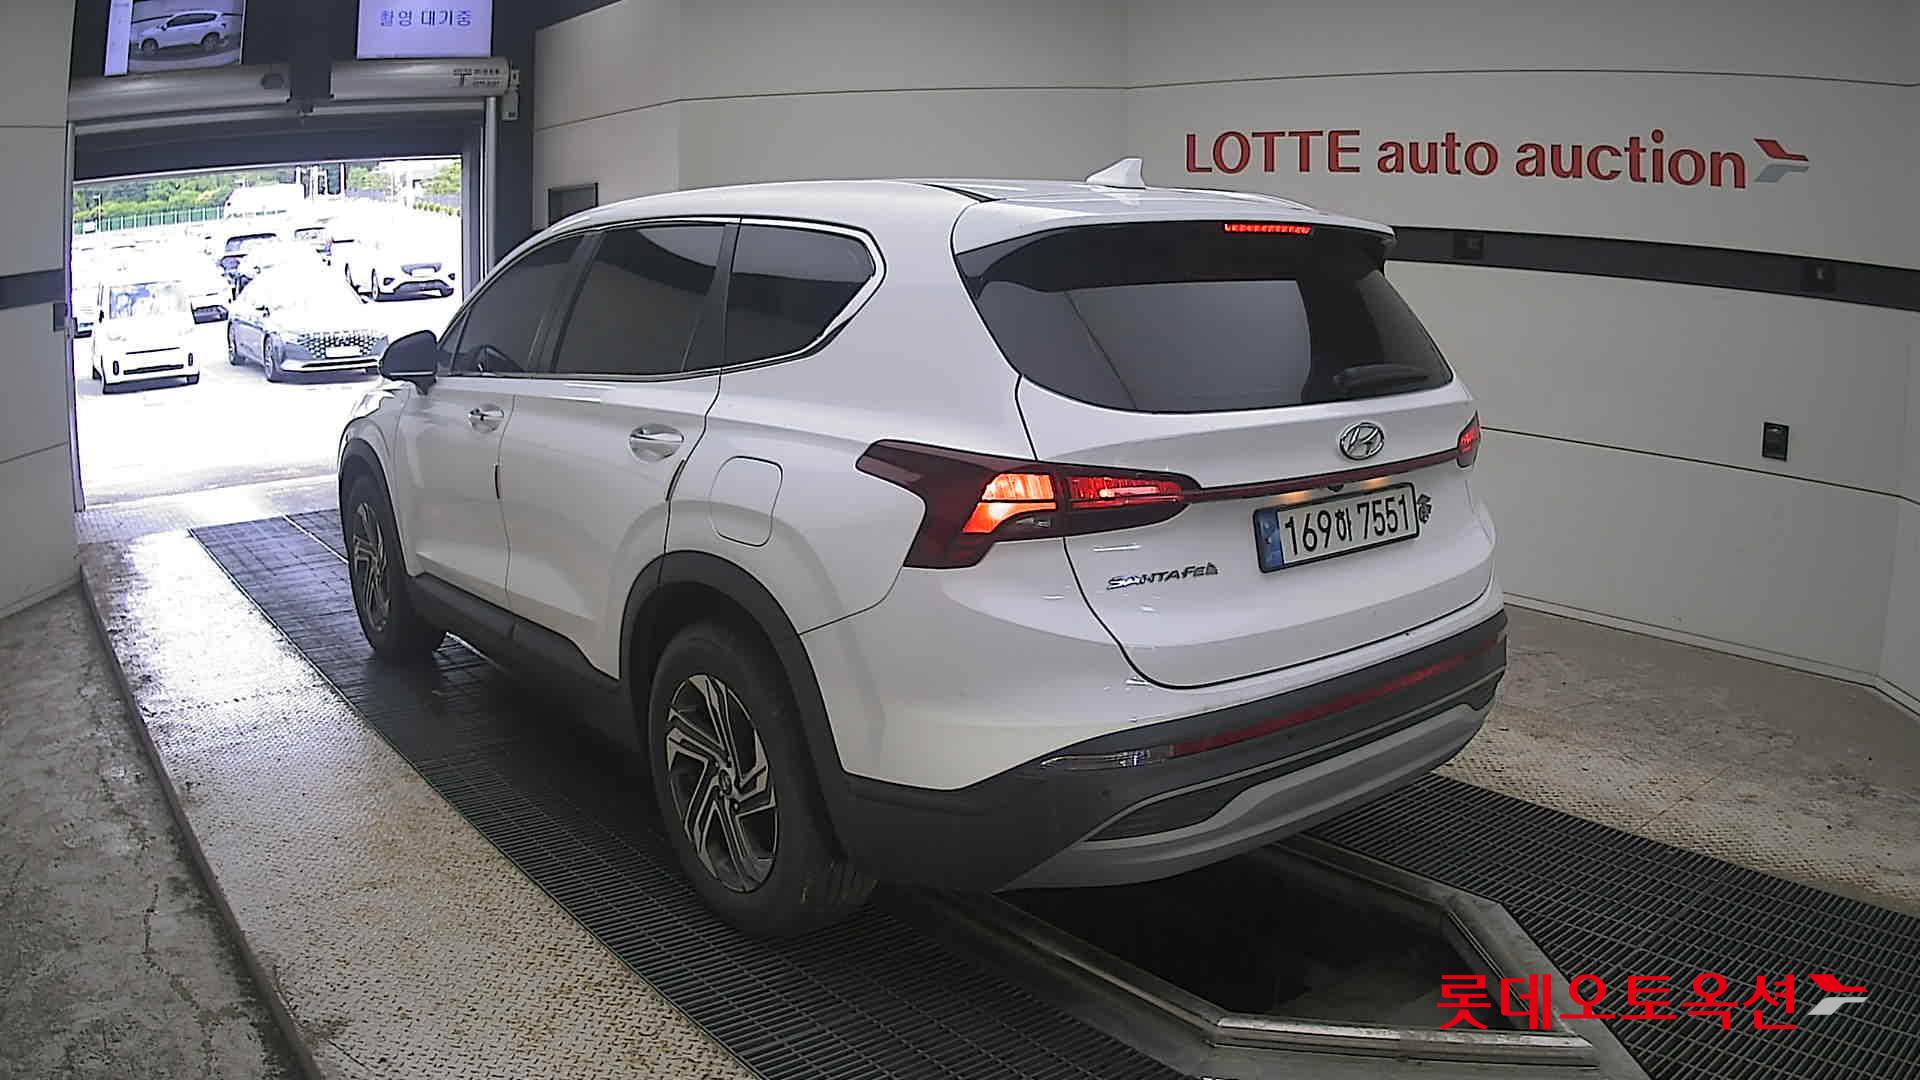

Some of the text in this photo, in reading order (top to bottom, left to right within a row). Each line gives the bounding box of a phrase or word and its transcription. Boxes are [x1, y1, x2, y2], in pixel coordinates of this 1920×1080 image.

[421, 9, 472, 26] 대기중
[1186, 130, 1746, 188] LOTTE auto auction
[1284, 493, 1409, 555] 169하 7551
